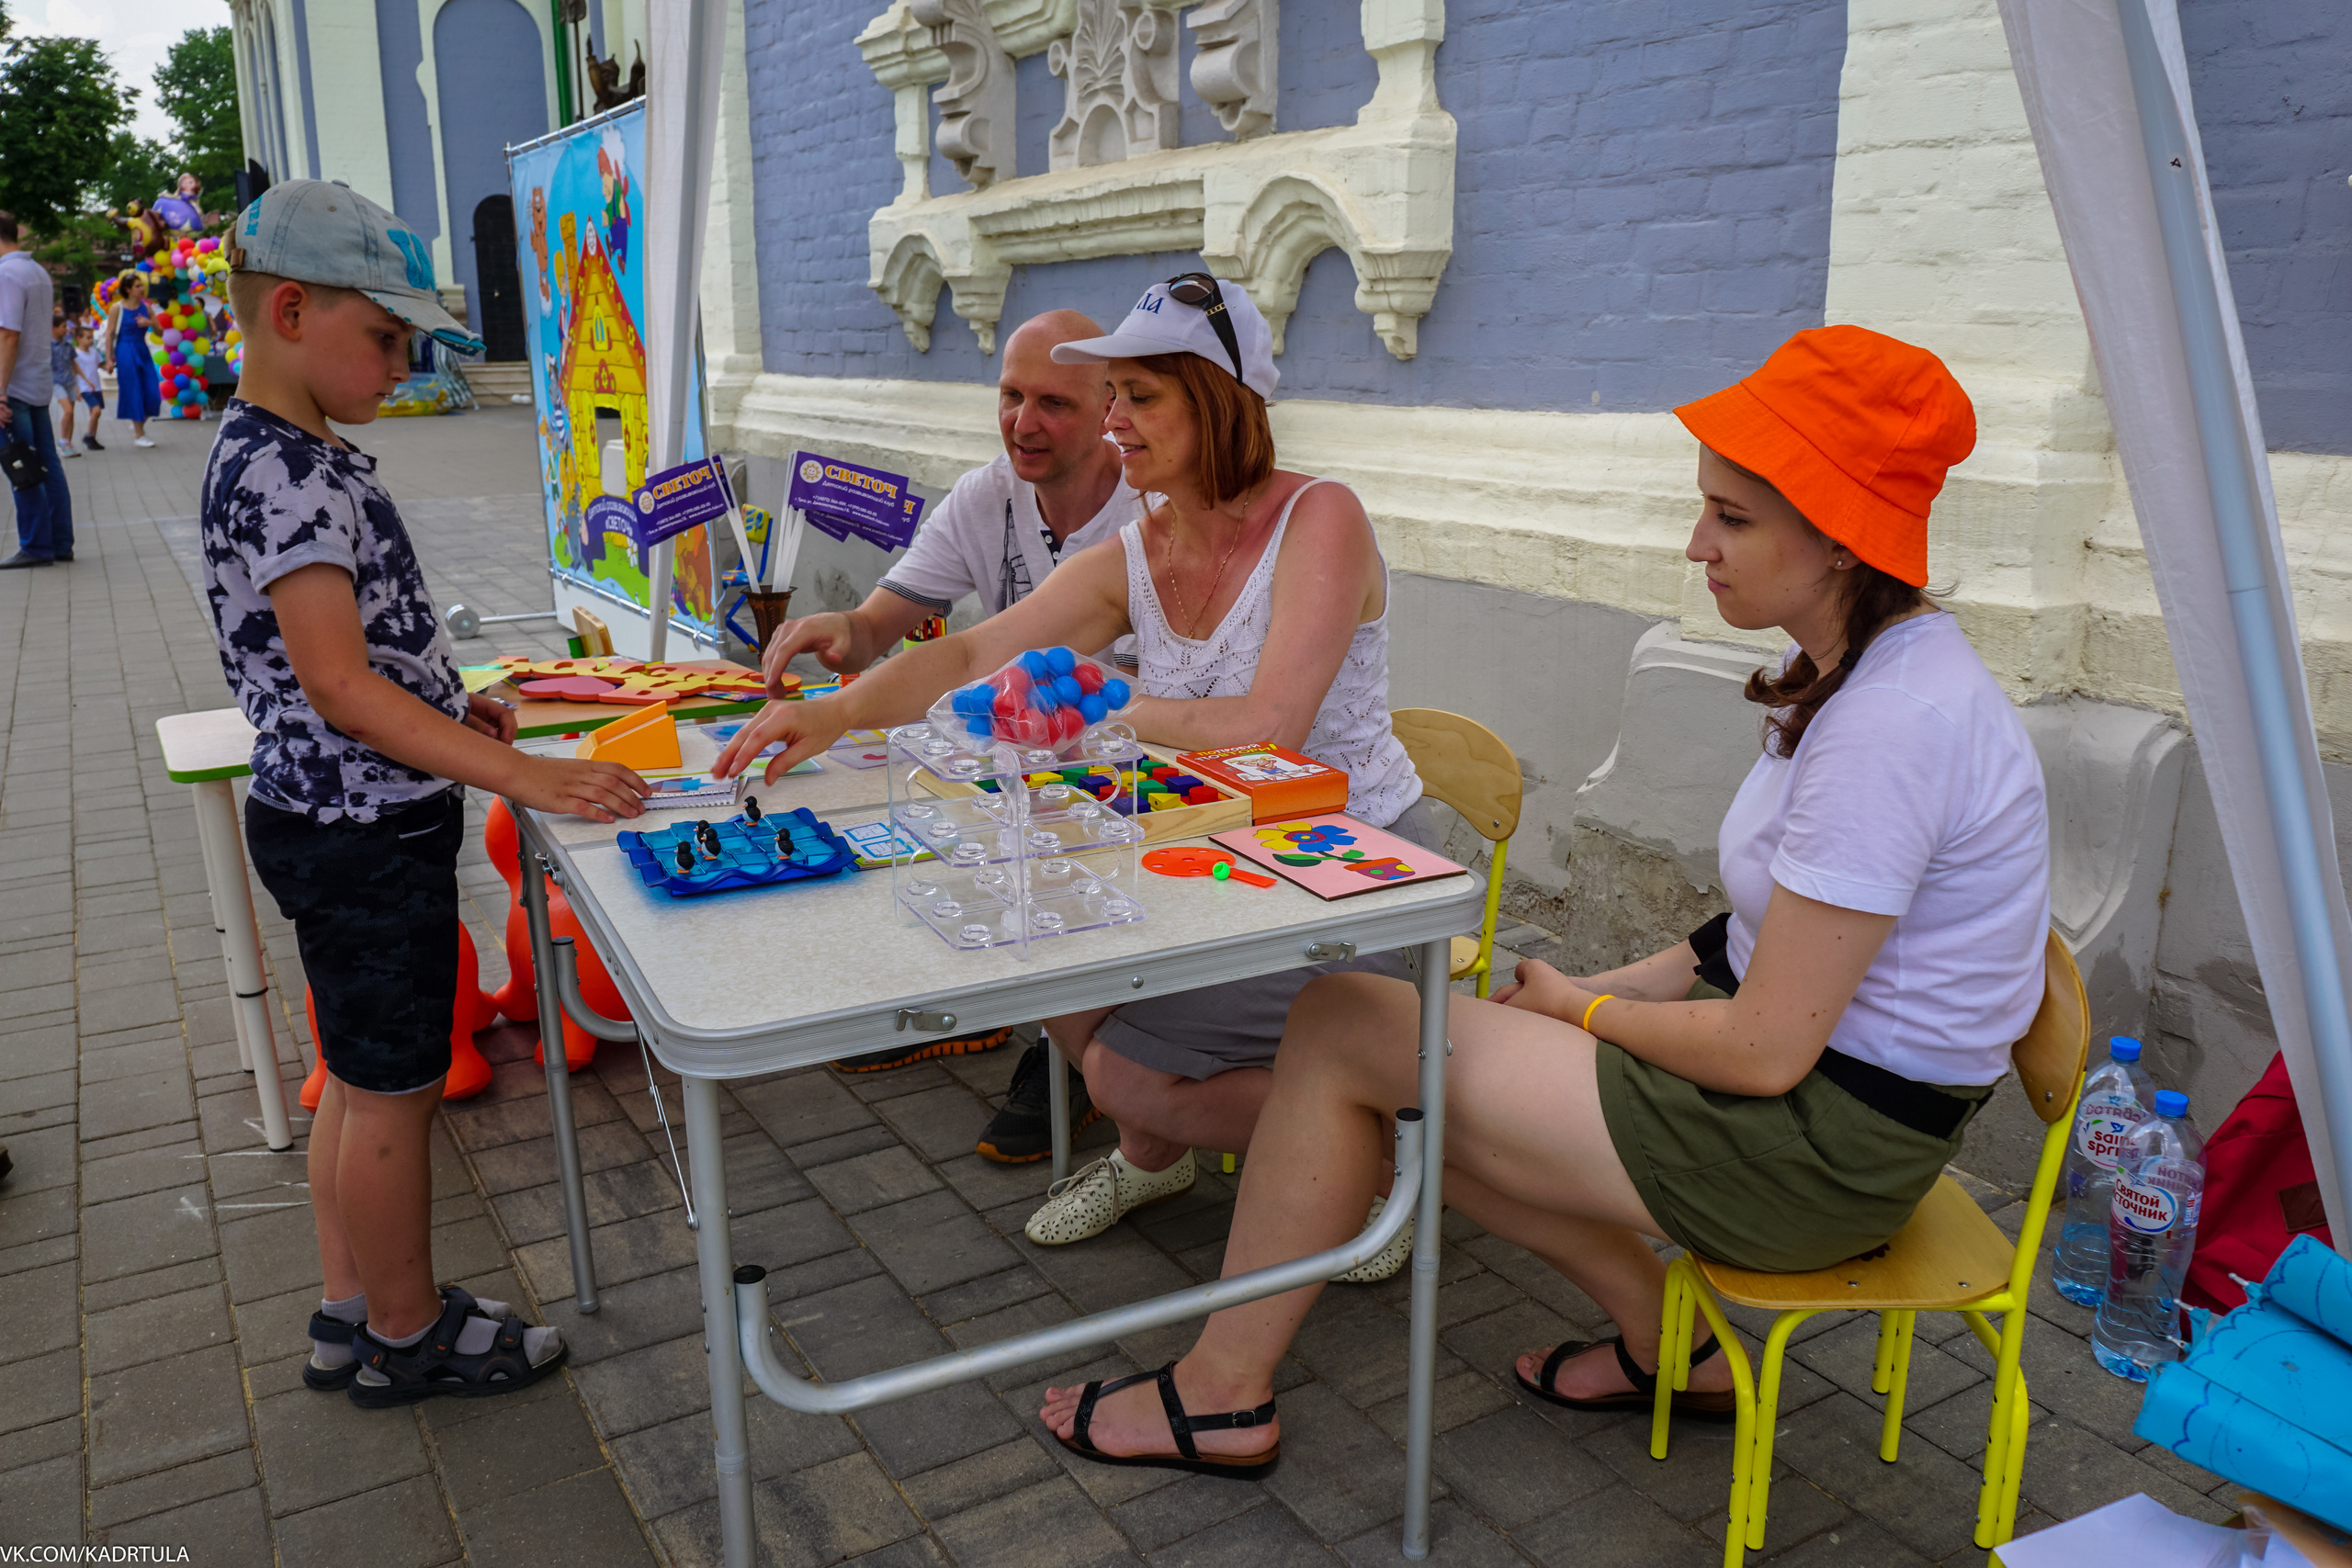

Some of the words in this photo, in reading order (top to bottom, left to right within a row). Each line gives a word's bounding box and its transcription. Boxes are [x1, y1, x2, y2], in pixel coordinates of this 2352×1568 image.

[652, 466, 713, 500] СВЕТОЧ
[822, 479, 848, 491] Детский
[848, 487, 883, 504] развивающий
[883, 497, 895, 508] клуб
[825, 465, 899, 499] СВЕТОЧ
[2113, 1190, 2168, 1222] СТОЧНИК
